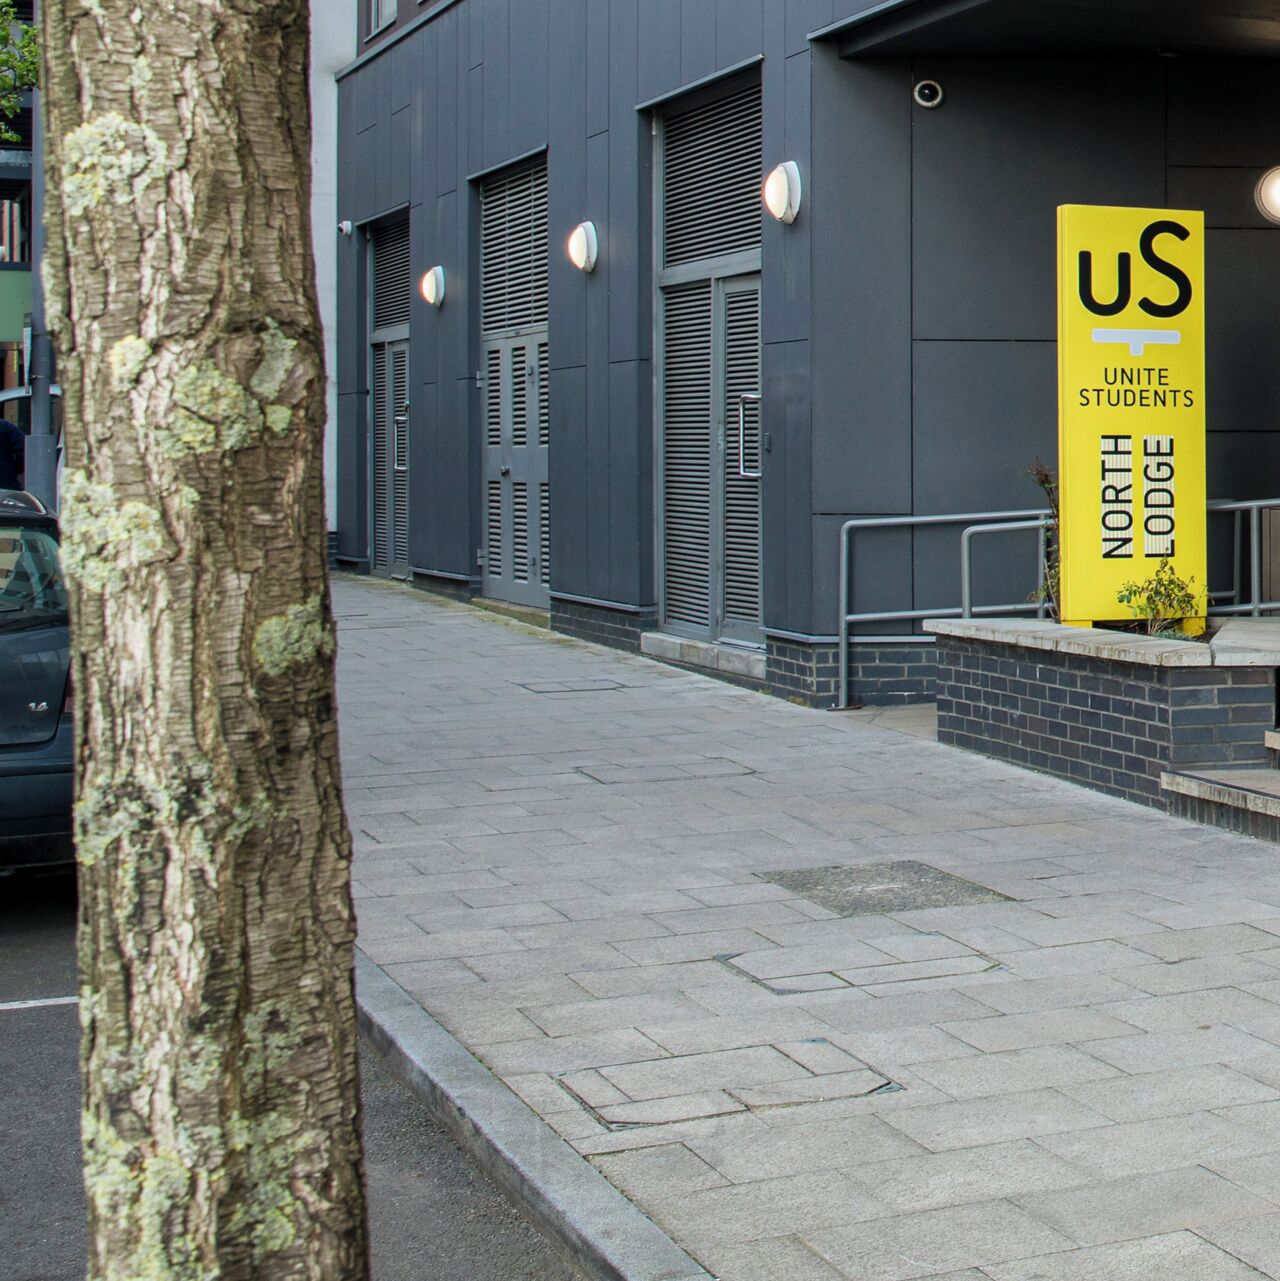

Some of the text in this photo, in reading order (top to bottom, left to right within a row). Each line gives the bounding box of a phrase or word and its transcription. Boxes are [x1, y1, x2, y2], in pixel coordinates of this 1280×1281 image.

[1079, 388, 1194, 408] STUDENTS
[1104, 367, 1169, 386] UNITE
[1101, 434, 1133, 559] NORTH
[1144, 435, 1175, 558] LODGE
